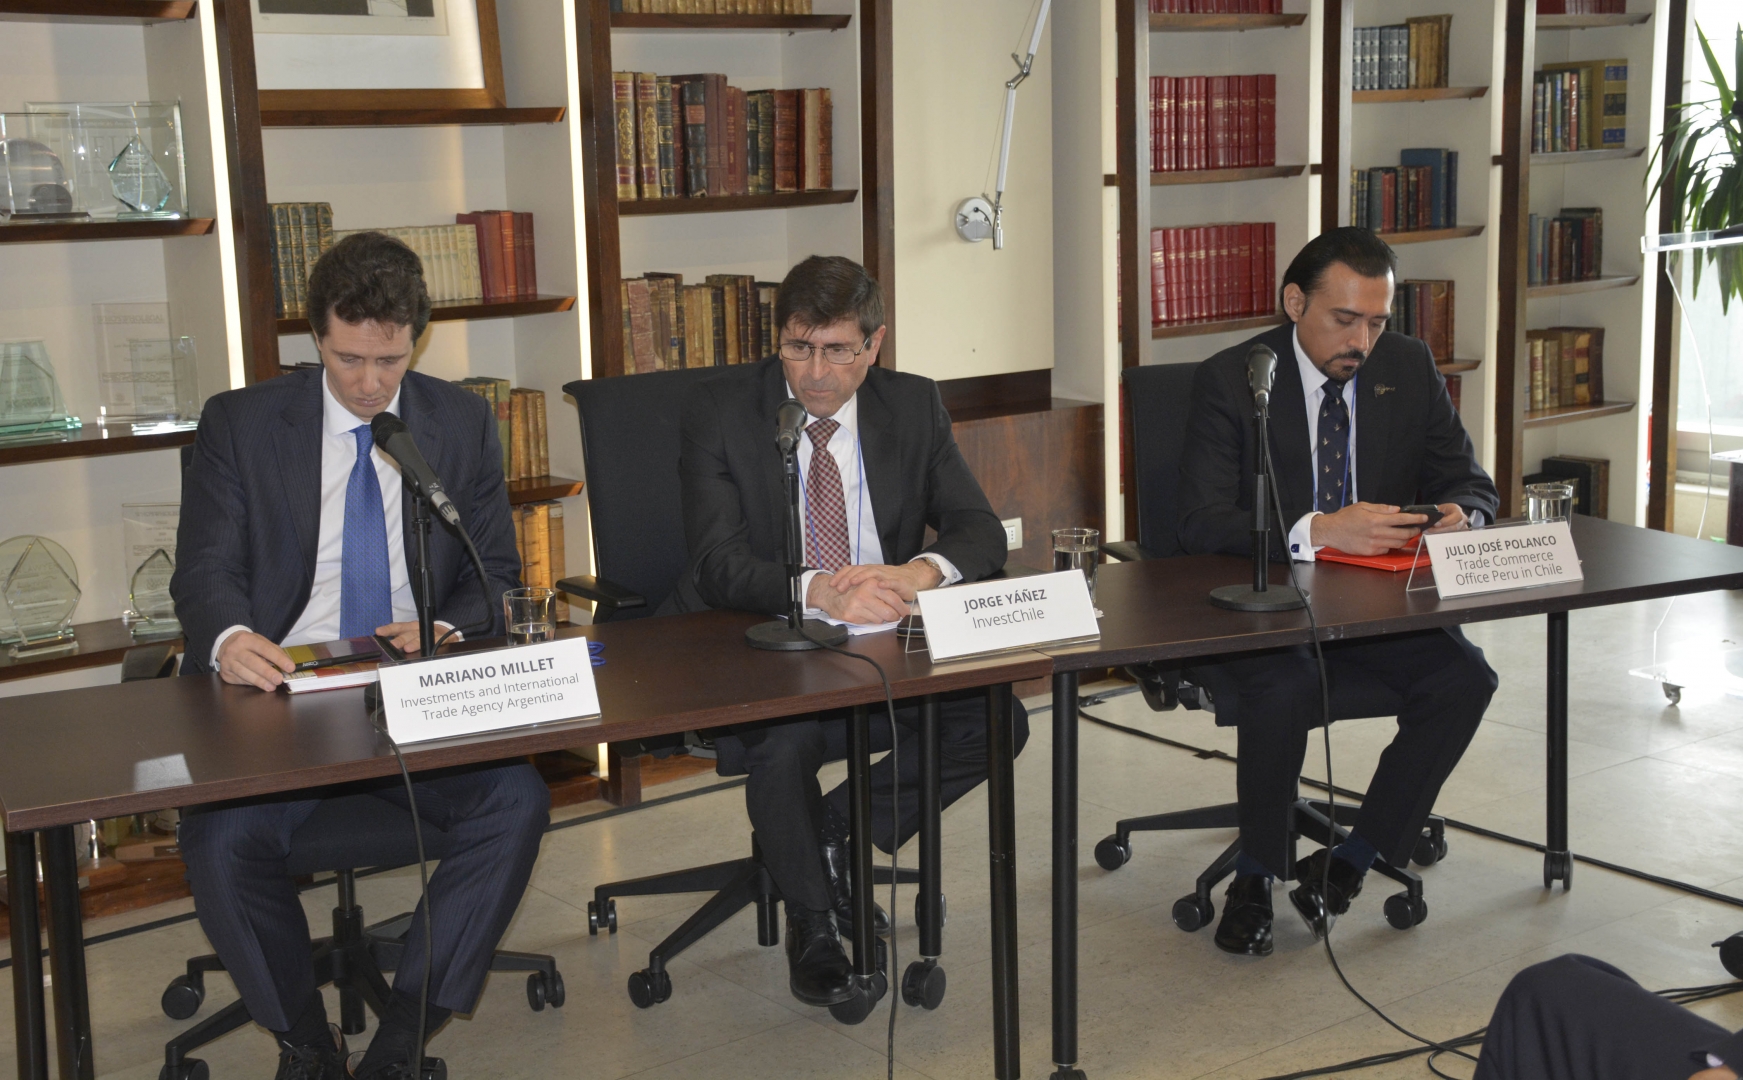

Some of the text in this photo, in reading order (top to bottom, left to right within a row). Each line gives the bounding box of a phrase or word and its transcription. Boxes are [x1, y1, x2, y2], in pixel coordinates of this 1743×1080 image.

[1445, 535, 1556, 559] JULIO JOSÉ POLANCO
[1455, 551, 1553, 570] Trade Commerce
[1455, 563, 1562, 585] Office Peru in Chile
[963, 588, 1047, 614] JORGE YÁÑEZ
[972, 607, 1044, 628] InvestChile
[418, 657, 554, 687] MARIANO MILLET
[400, 672, 578, 707] Investments and International
[421, 692, 563, 719] Trade Agency Argentina
